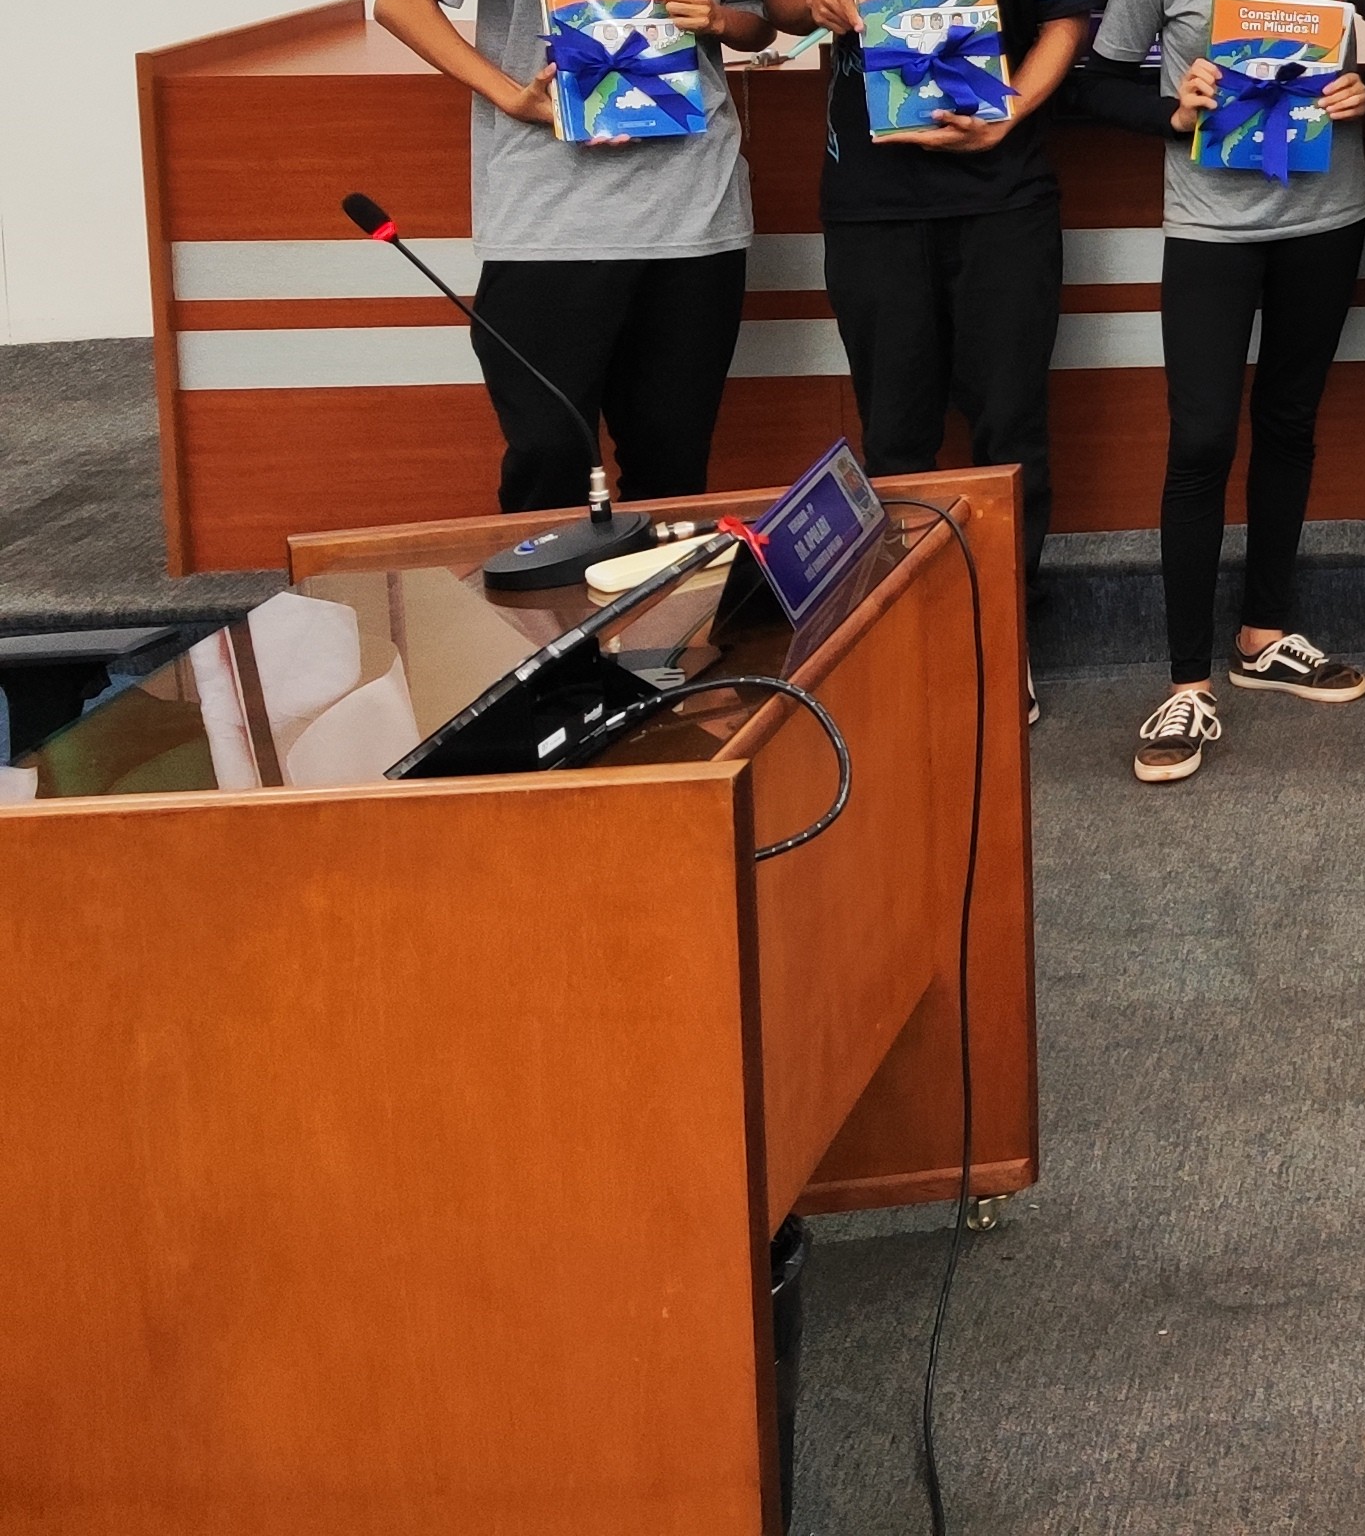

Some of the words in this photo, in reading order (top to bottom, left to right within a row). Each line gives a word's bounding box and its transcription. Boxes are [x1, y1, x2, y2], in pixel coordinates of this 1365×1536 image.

[1239, 7, 1320, 24] Constituição
[1241, 22, 1261, 31] em
[1264, 20, 1308, 34] Miúdos
[1310, 25, 1319, 35] II
